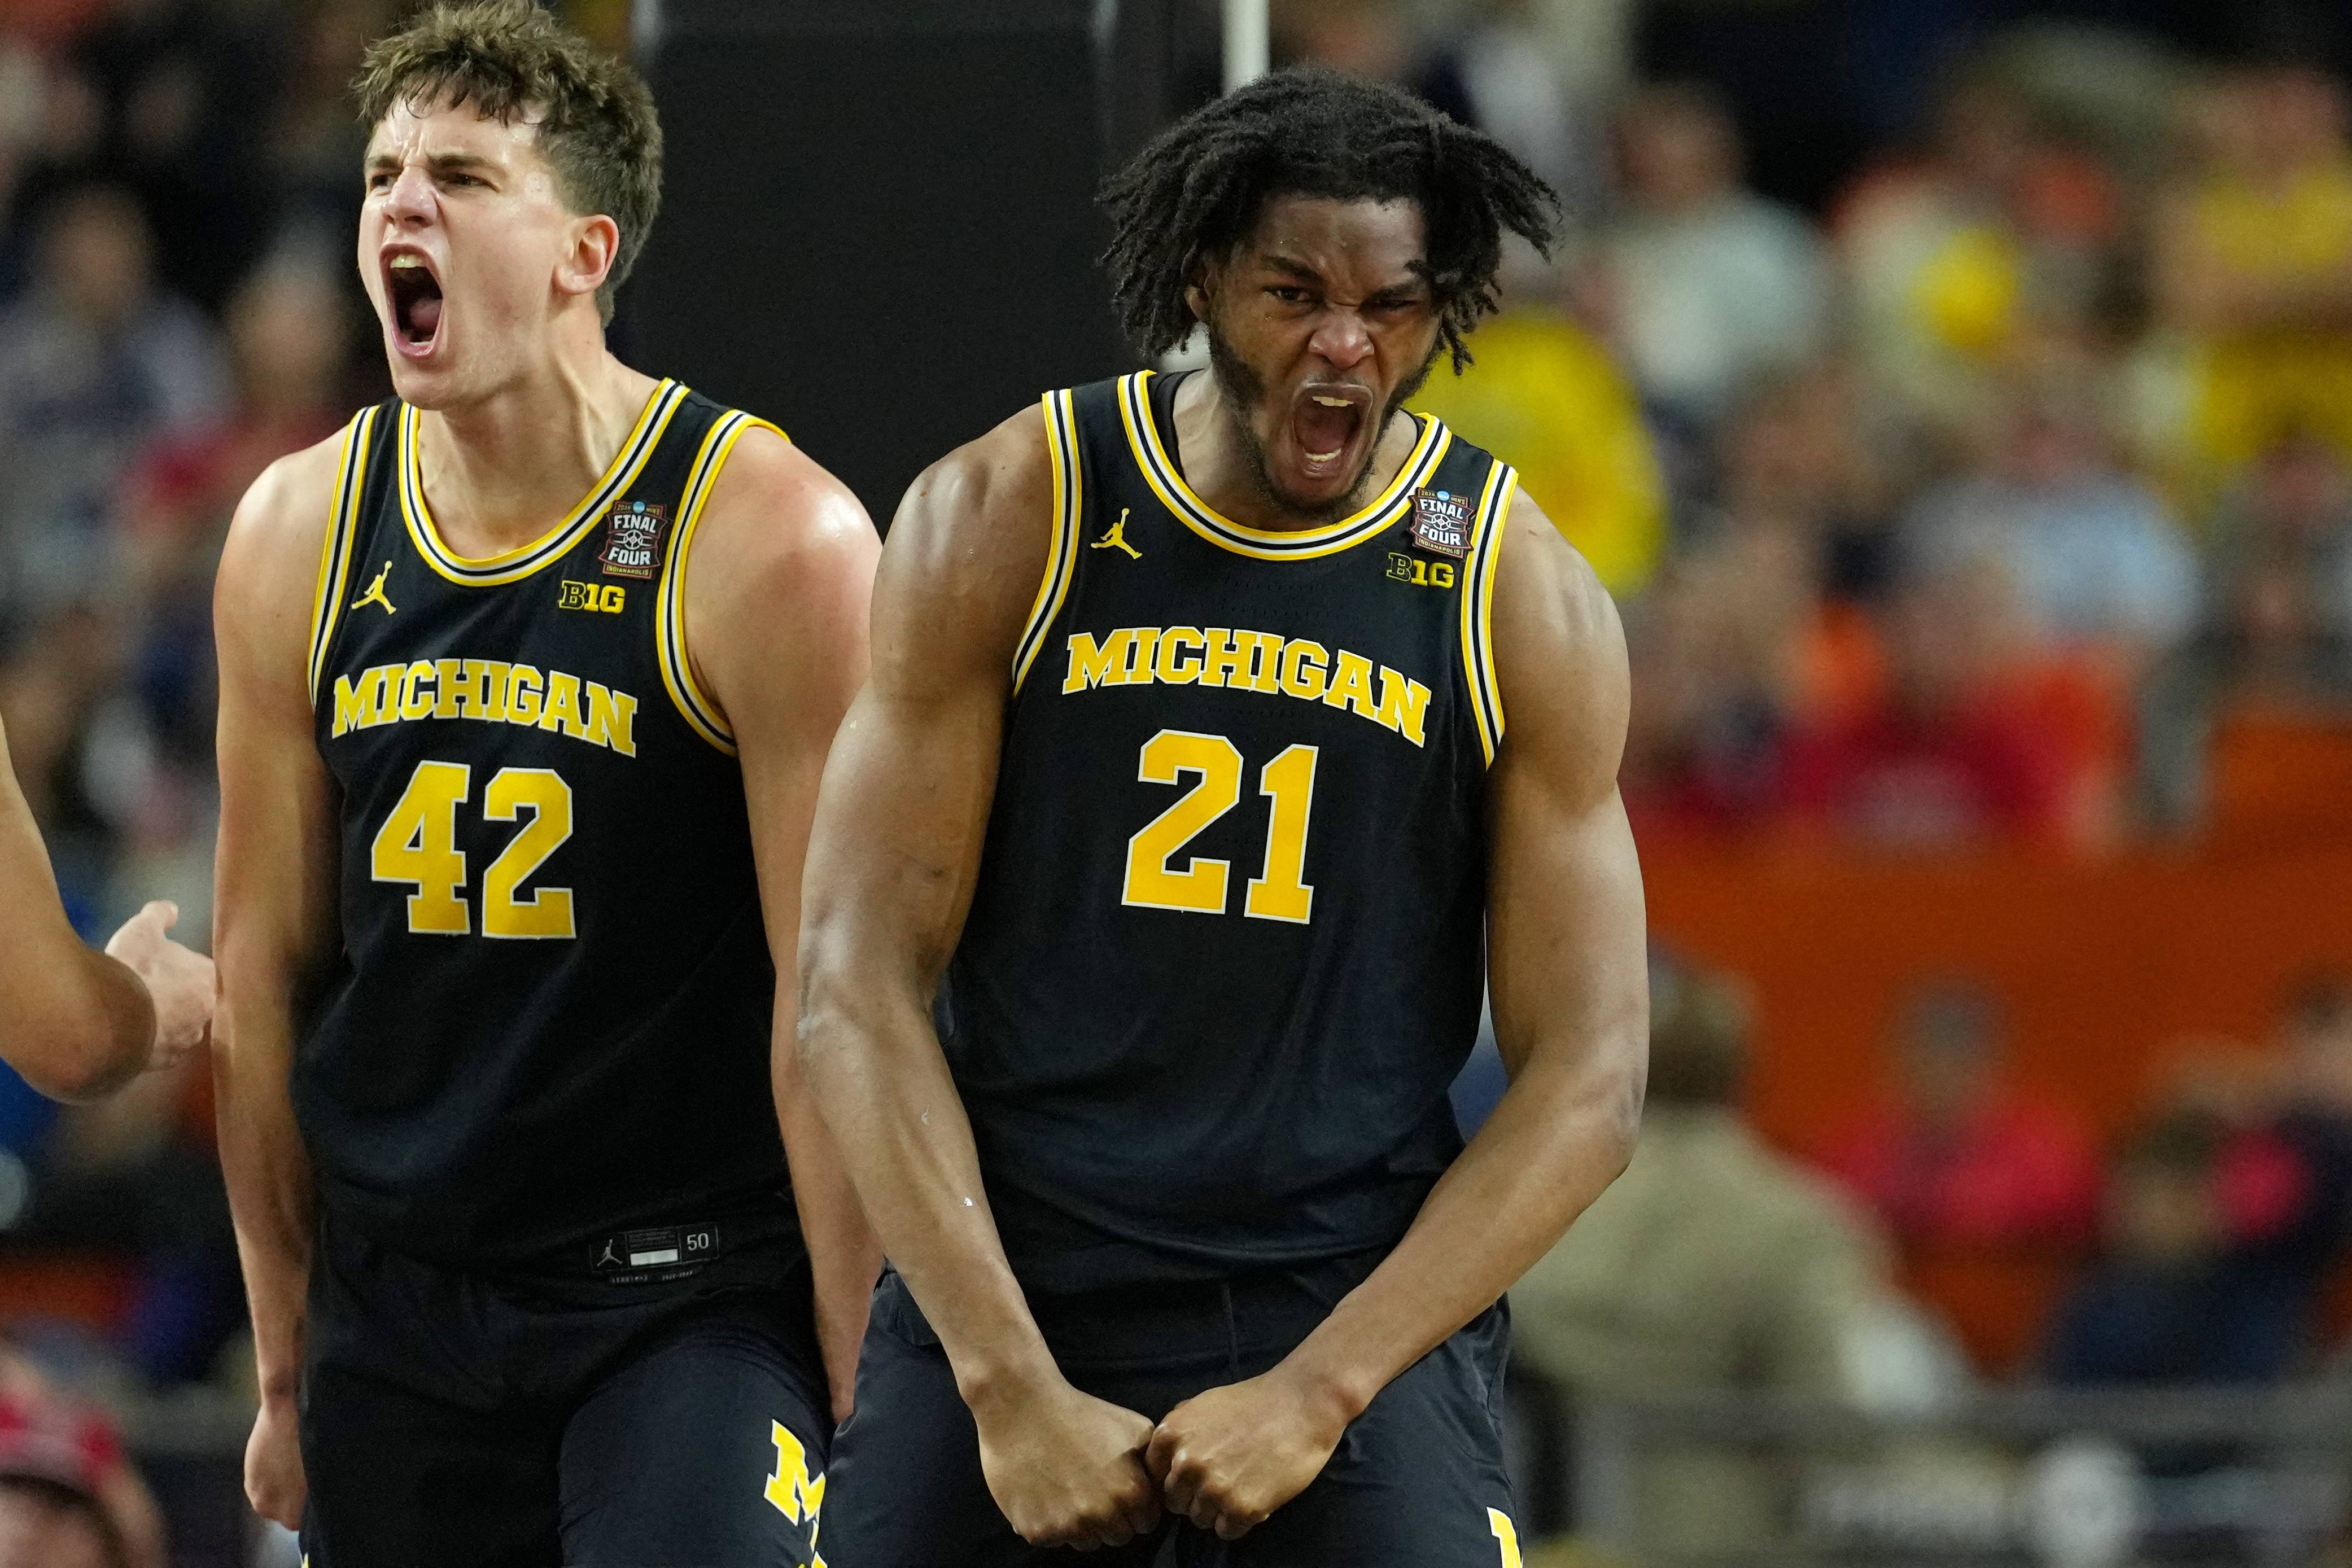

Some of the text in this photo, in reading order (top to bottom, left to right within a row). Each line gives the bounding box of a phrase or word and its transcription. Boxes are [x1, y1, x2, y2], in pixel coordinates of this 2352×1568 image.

[1419, 499, 1464, 520] FINAL
[614, 514, 657, 534] FINAL
[1419, 524, 1462, 546] FOUR
[607, 546, 652, 566] FOUR
[1418, 538, 1461, 555] INDIANAPOLIS
[606, 565, 649, 576] INDIANAPOLIS
[1062, 625, 1432, 748] MICHIGAN
[332, 658, 638, 758] MICHIGAN
[1121, 729, 1319, 925] 21
[371, 760, 577, 938] 42
[687, 1233, 710, 1251] 50
